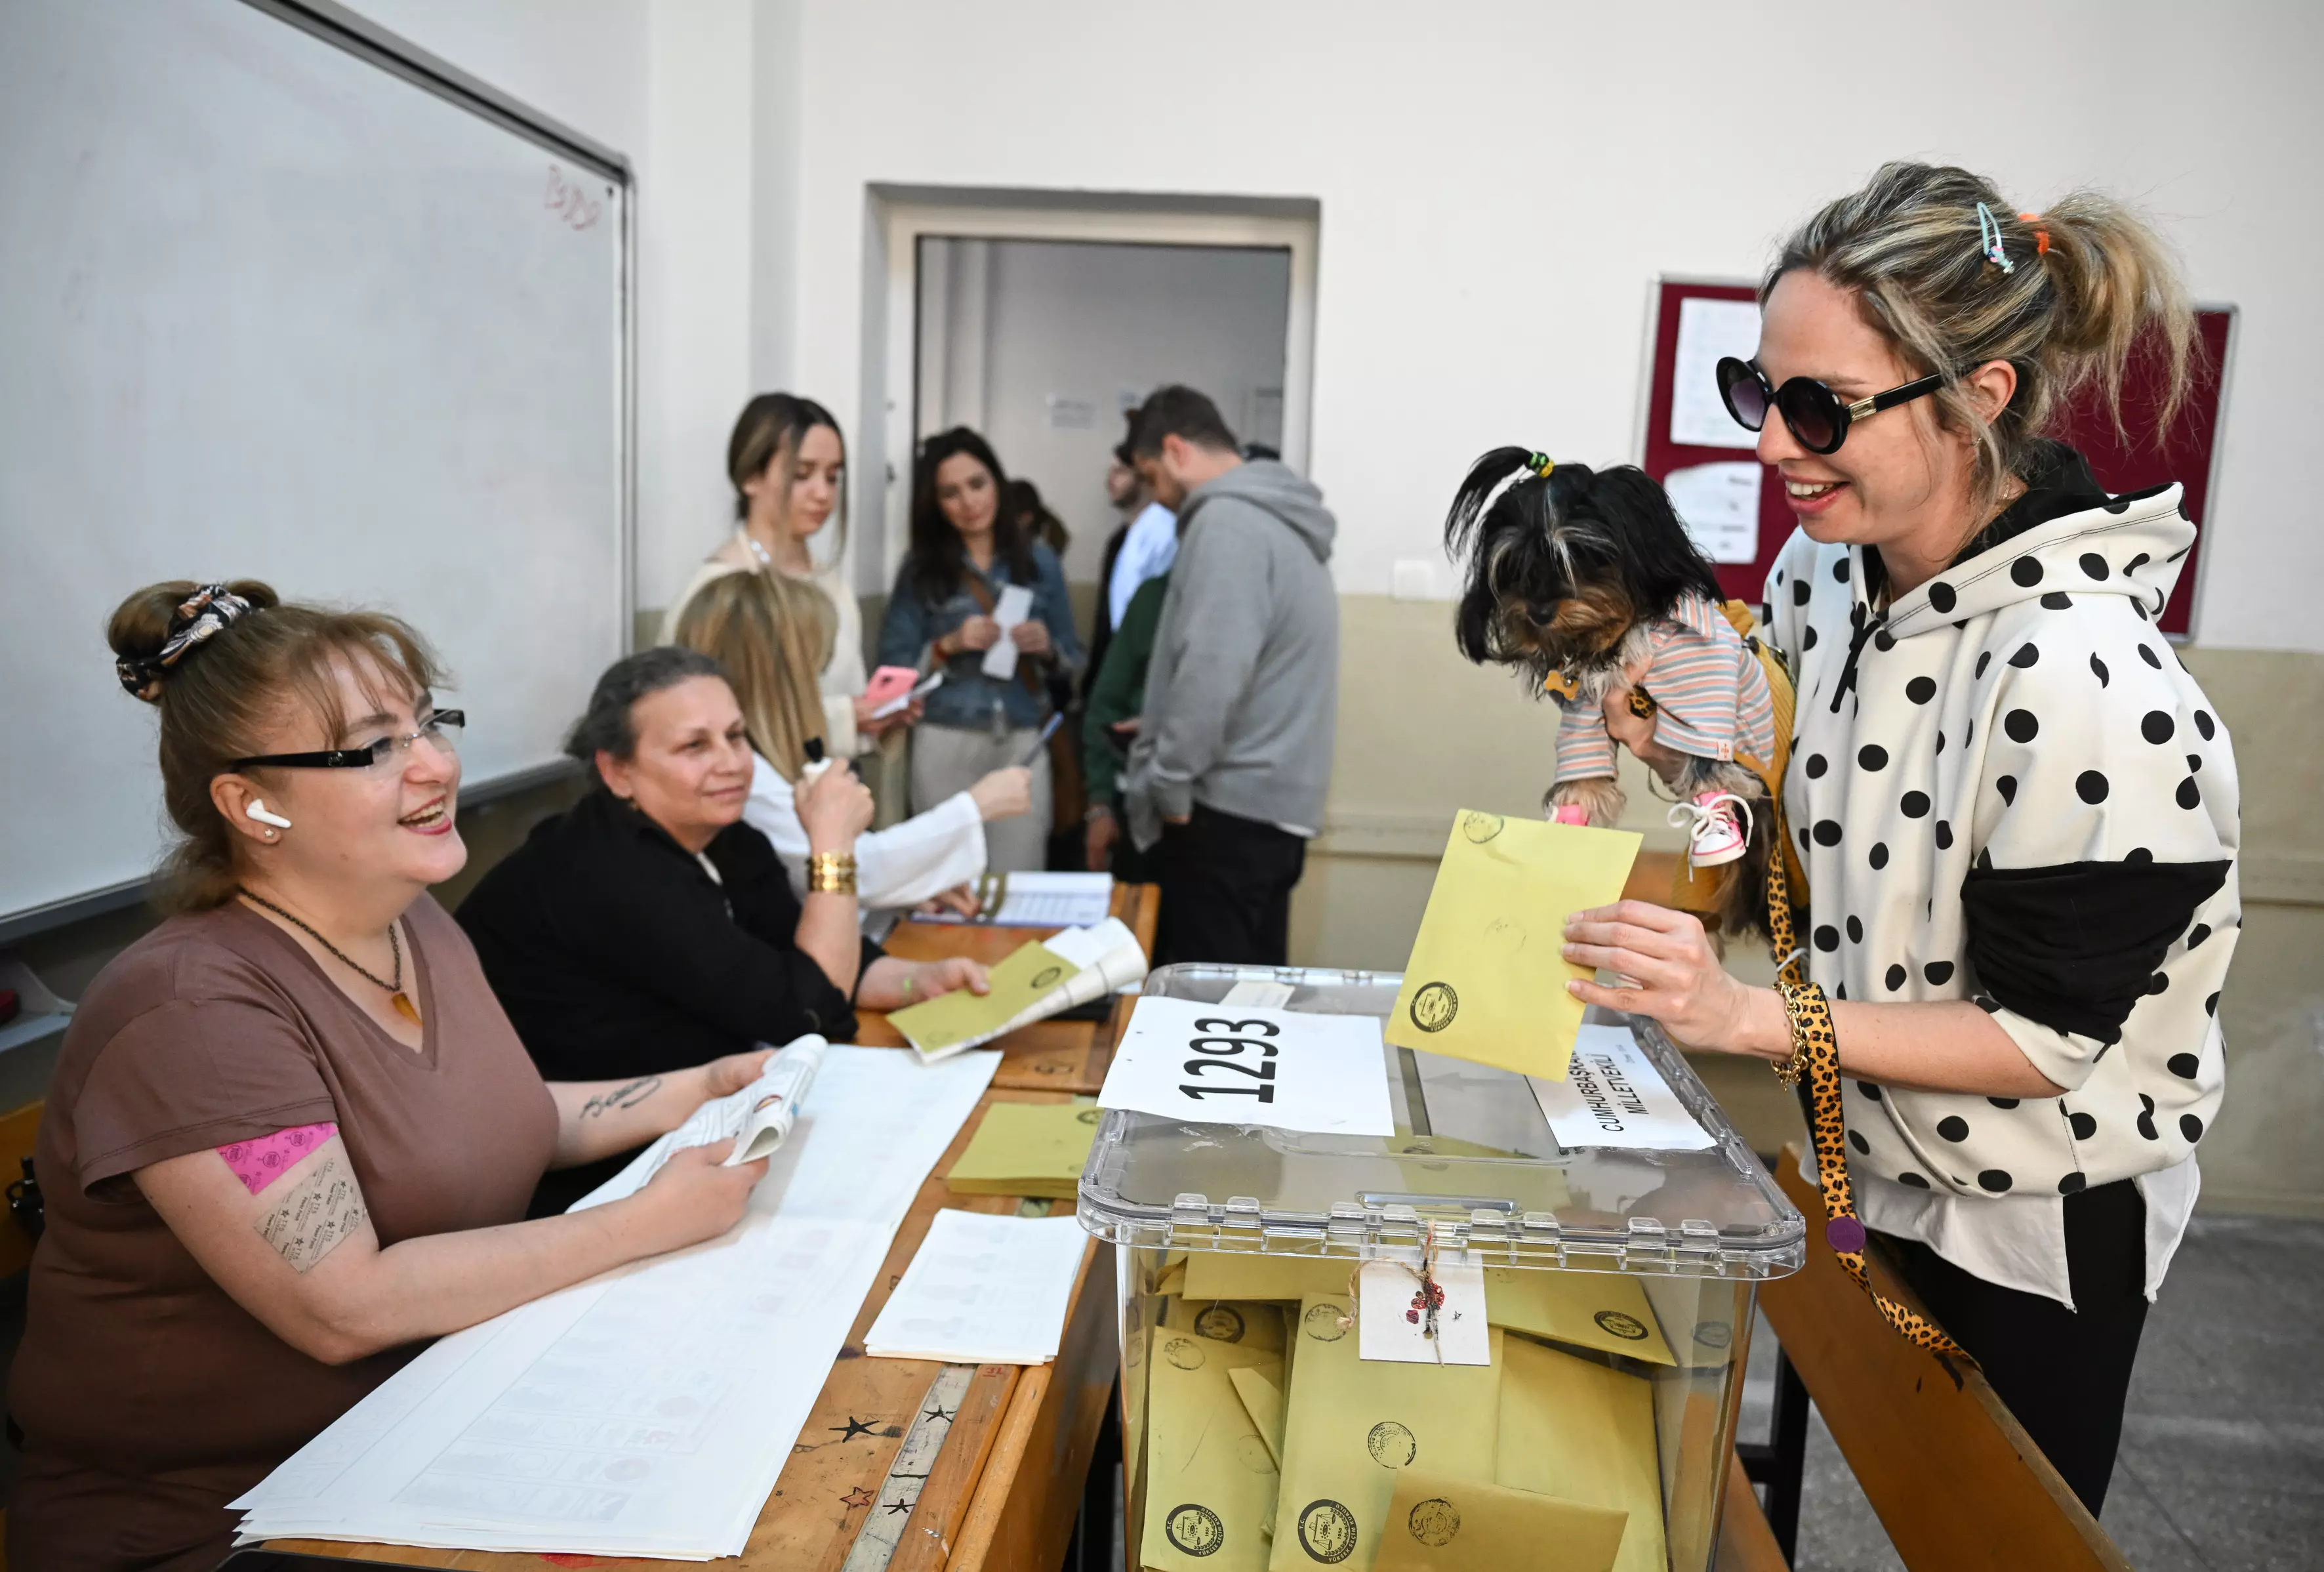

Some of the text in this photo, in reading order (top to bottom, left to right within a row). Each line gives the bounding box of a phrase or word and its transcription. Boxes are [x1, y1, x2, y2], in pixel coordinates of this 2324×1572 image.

[1179, 1018, 1280, 1104] 1293
[1585, 1054, 1649, 1114] MİLLETVEKİLİ
[1201, 1508, 1220, 1525] KURULU
[1335, 1504, 1355, 1525] KURULU
[1198, 1544, 1218, 1556] YÜKSEK
[1328, 1549, 1350, 1562] YÜKSEK
